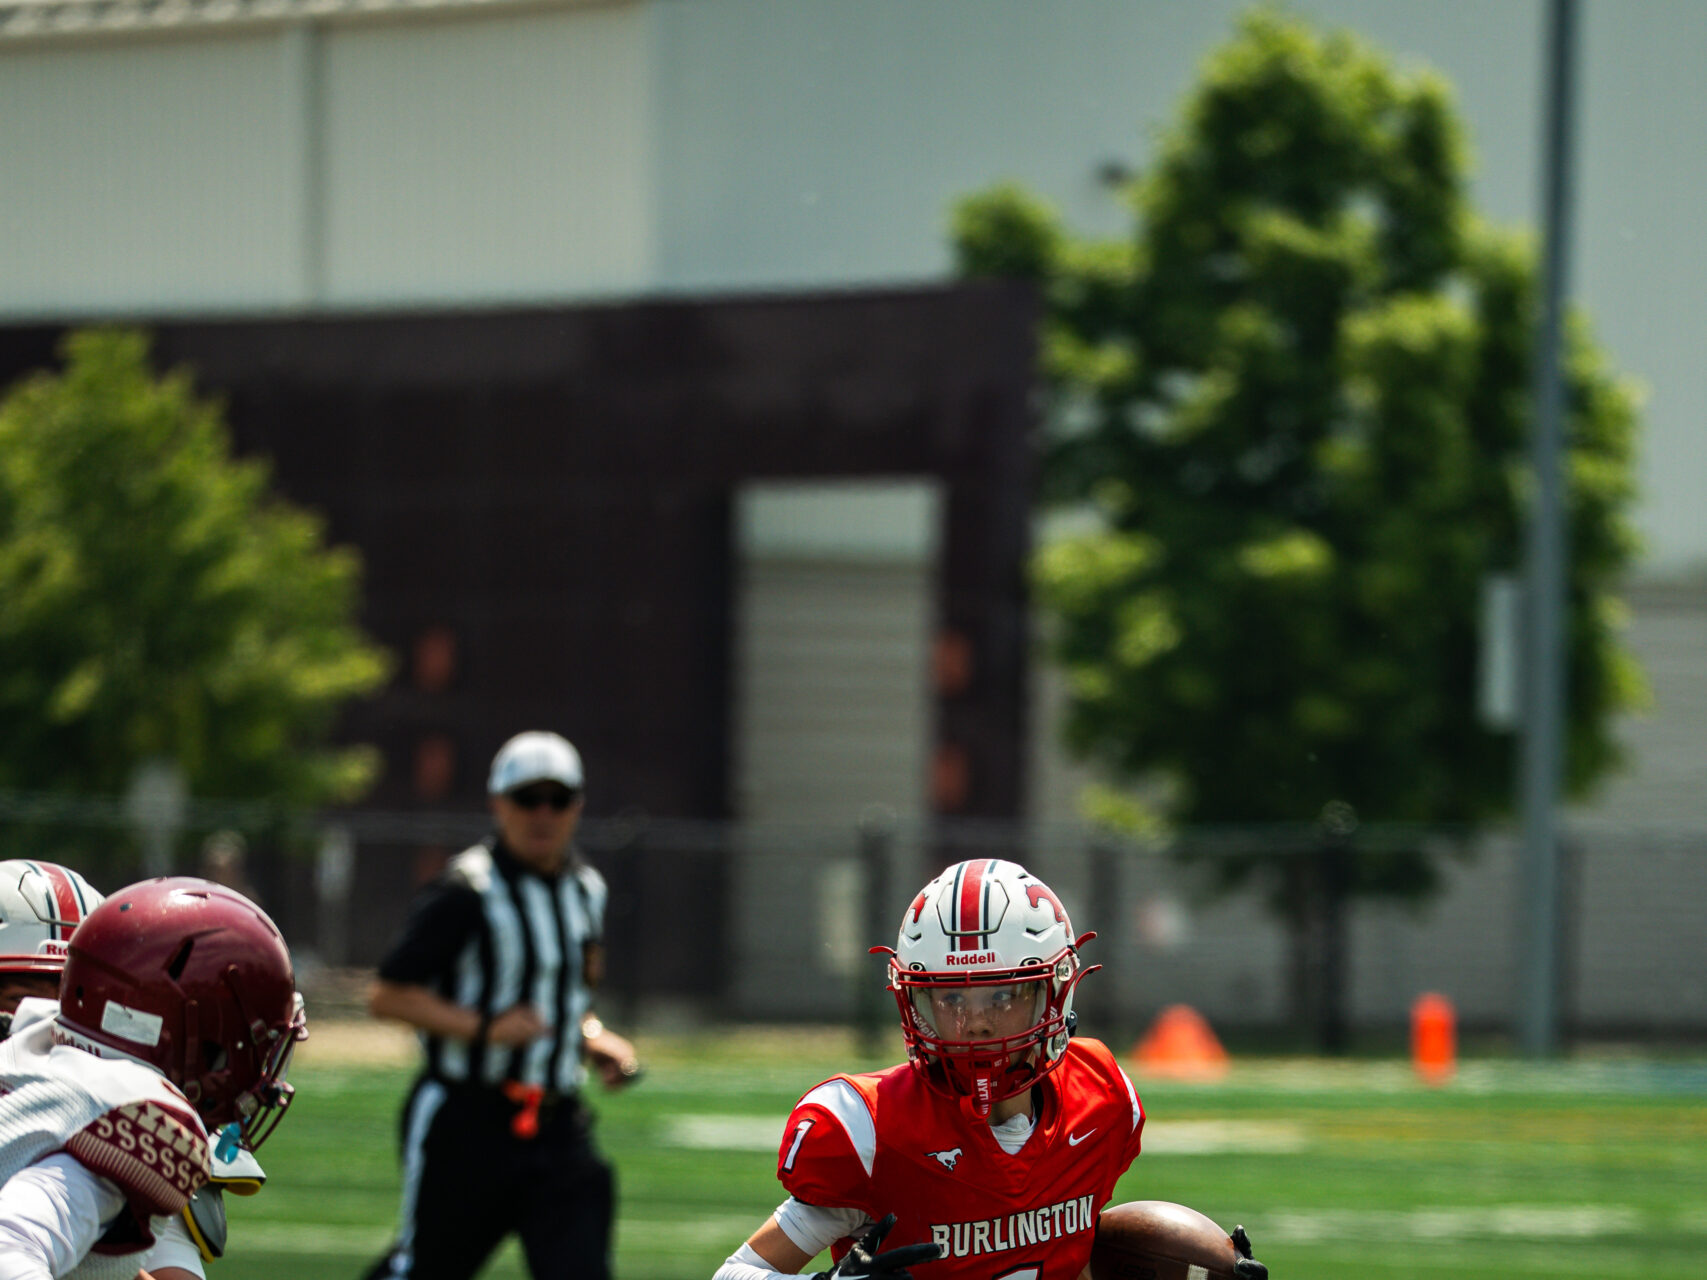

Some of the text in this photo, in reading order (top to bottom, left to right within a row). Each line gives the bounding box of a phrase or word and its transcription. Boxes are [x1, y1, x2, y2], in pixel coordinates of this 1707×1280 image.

[946, 951, 996, 966] Riddell
[782, 1118, 817, 1174] 1
[929, 1193, 1095, 1260] BURLINGTON
